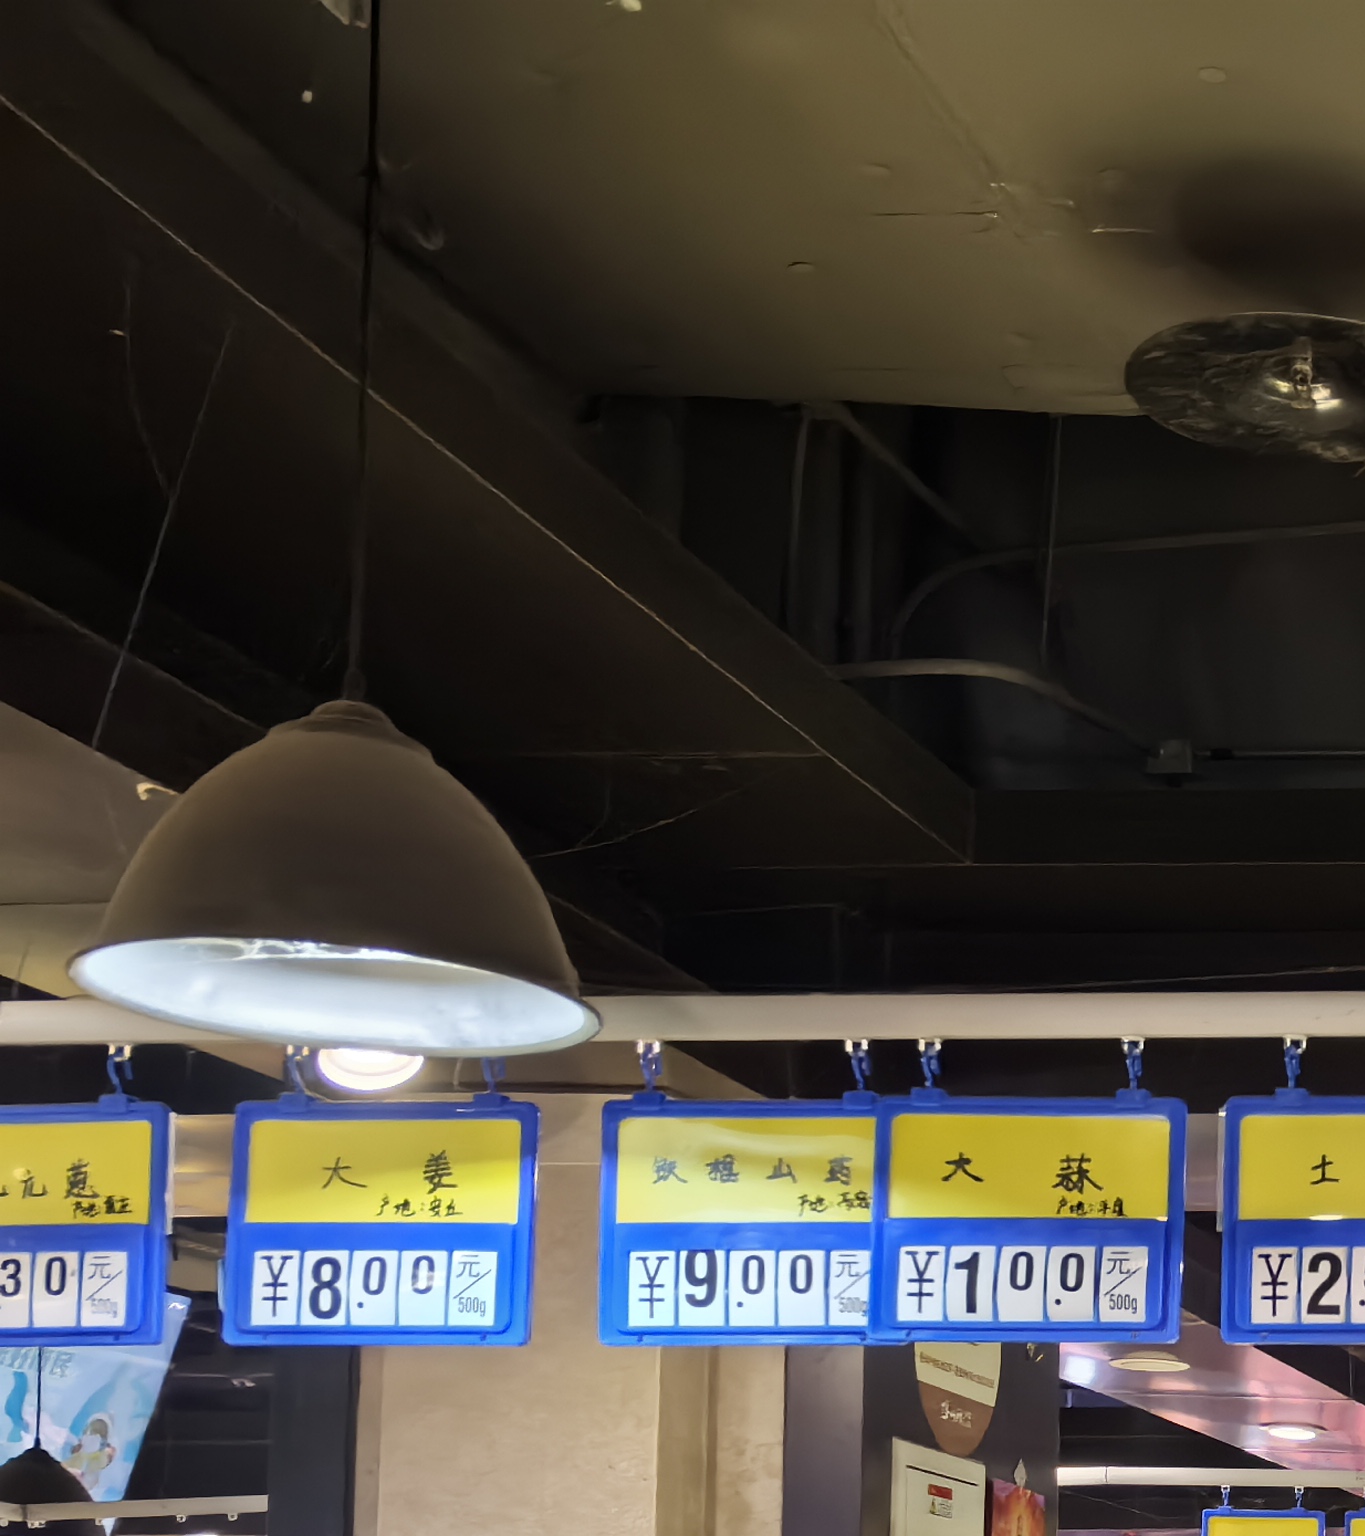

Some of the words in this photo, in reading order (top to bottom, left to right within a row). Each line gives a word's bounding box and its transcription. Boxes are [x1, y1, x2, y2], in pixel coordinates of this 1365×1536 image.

[0, 1158, 98, 1199] 元葱
[322, 1150, 458, 1194] 大姜
[941, 1152, 1104, 1194] 大蒜
